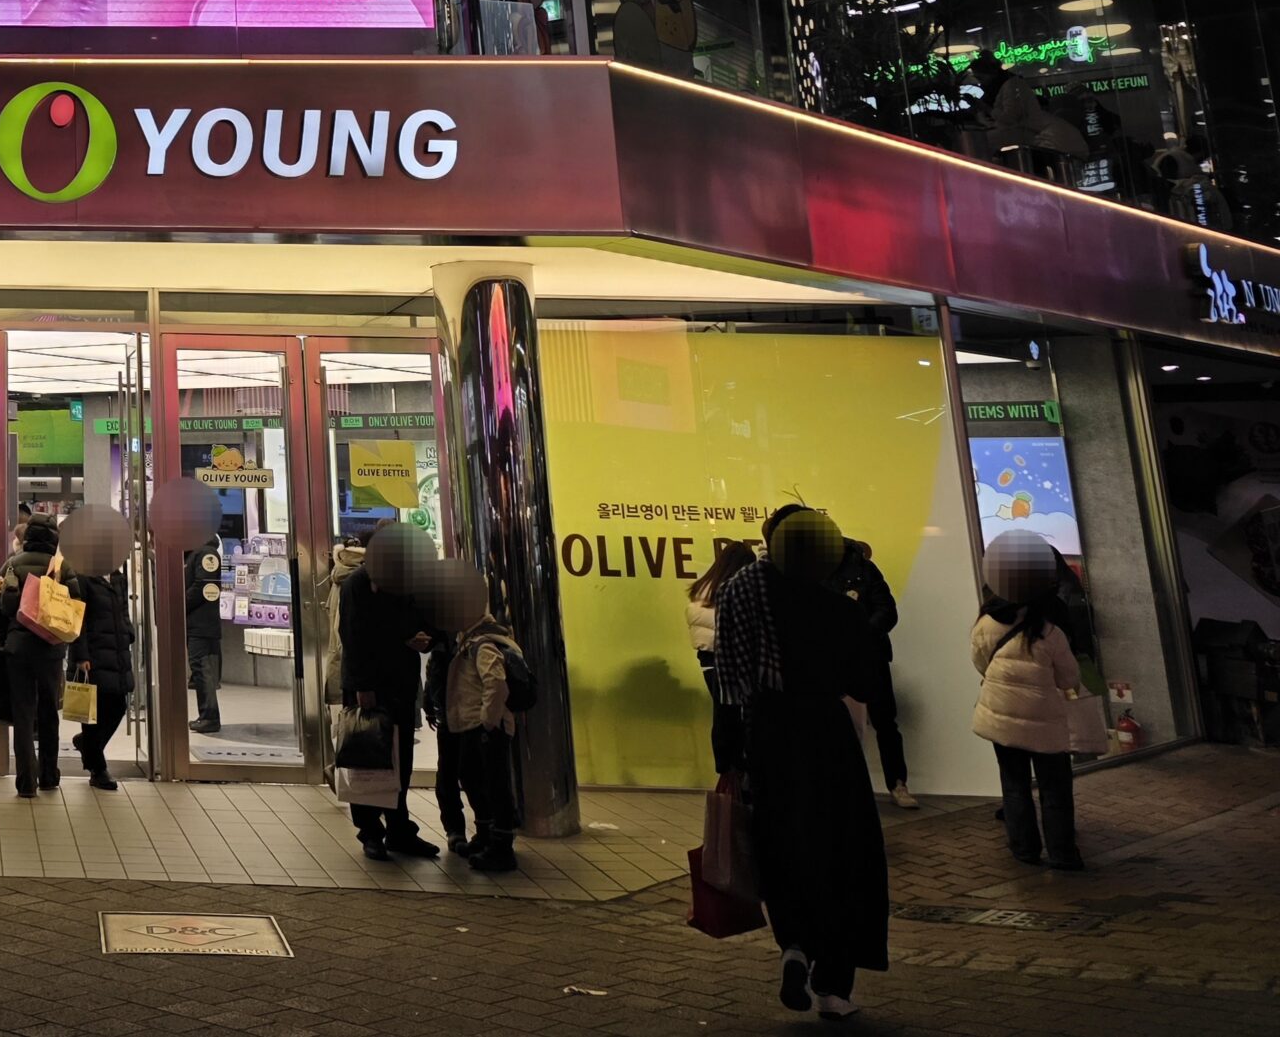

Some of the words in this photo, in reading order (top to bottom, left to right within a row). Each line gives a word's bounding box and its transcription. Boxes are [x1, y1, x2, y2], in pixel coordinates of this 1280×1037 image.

[1090, 81, 1111, 94] TAX
[133, 108, 458, 180] YOUNG
[968, 405, 1005, 419] ITEMS
[1007, 404, 1039, 418] WITH
[193, 420, 213, 430] OLIVE
[214, 419, 238, 429] YOUNG
[368, 416, 388, 427] ONLY
[390, 416, 413, 426] OLIVE
[415, 415, 434, 426] YOUN
[202, 474, 231, 483] OLIVE
[233, 475, 268, 483] YOUNG
[357, 468, 381, 477] OLIVE
[383, 469, 410, 477] BETTER
[597, 503, 668, 520] 올리브영이
[672, 505, 701, 521] 만든
[704, 507, 736, 520] NEW
[561, 533, 698, 580] OLIVE
[146, 925, 237, 936] D&C
